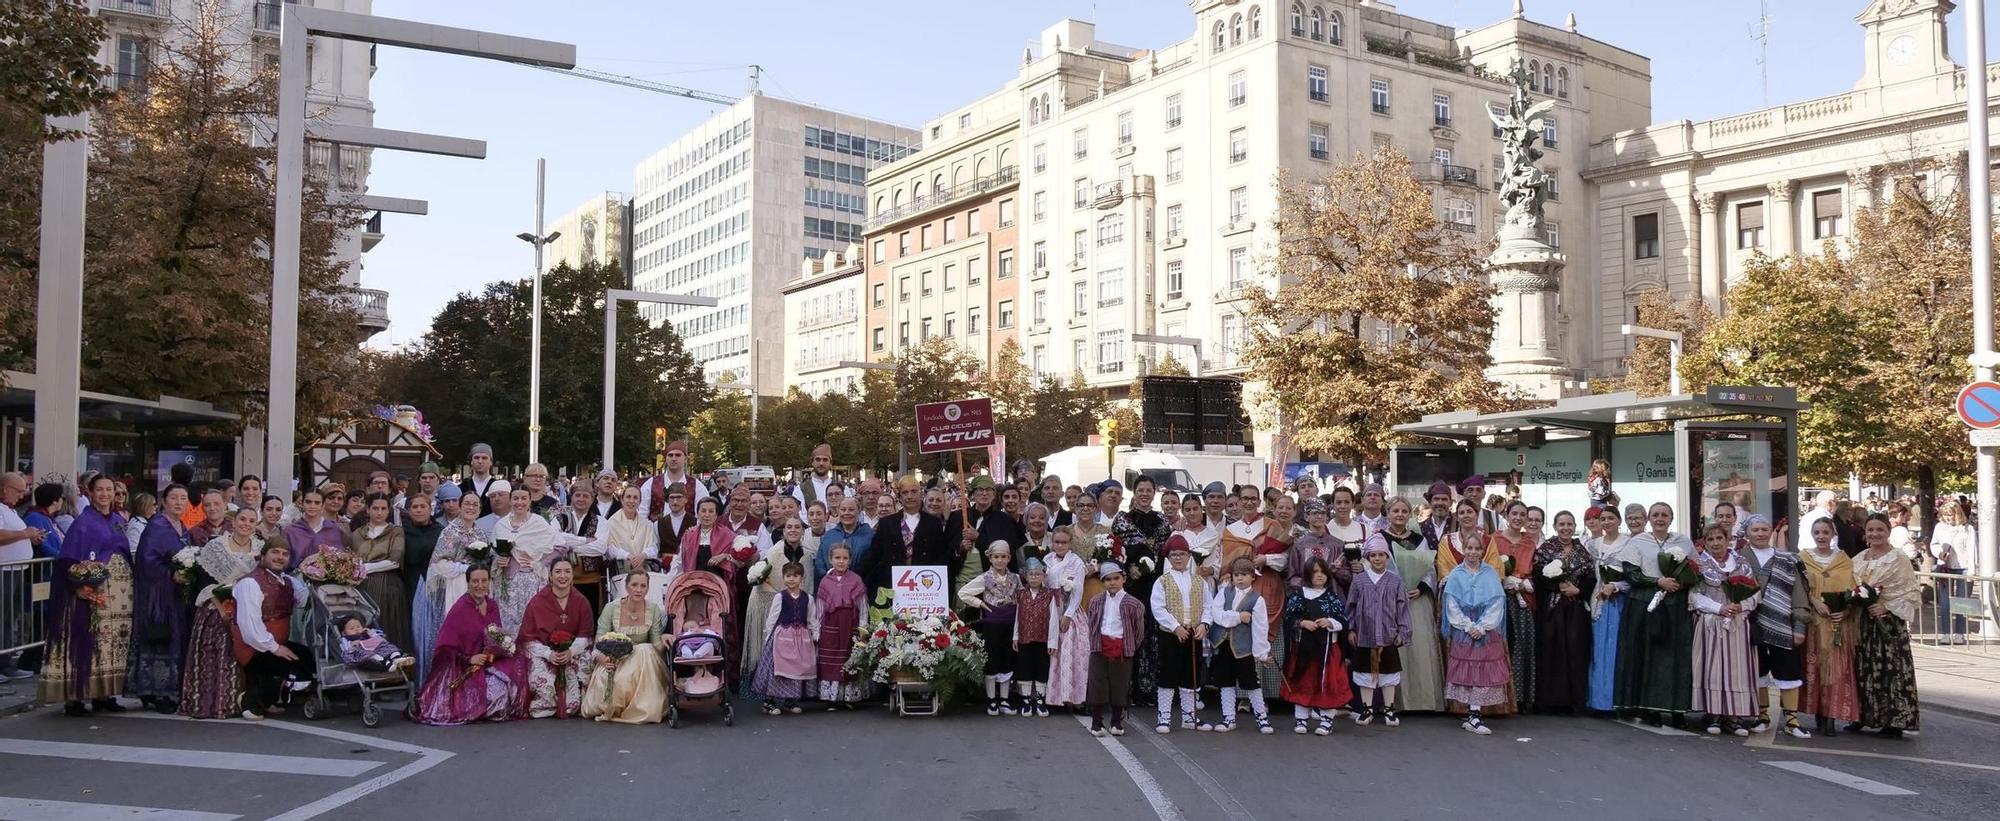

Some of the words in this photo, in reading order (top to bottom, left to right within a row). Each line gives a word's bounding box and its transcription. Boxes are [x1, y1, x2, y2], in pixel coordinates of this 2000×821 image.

[951, 421, 981, 430] CICLISTA
[922, 429, 992, 445] ACTUR
[1538, 470, 1556, 480] Gana
[1556, 469, 1583, 482] Energía
[1645, 467, 1668, 478] Gana
[897, 606, 946, 615] ACTUR
